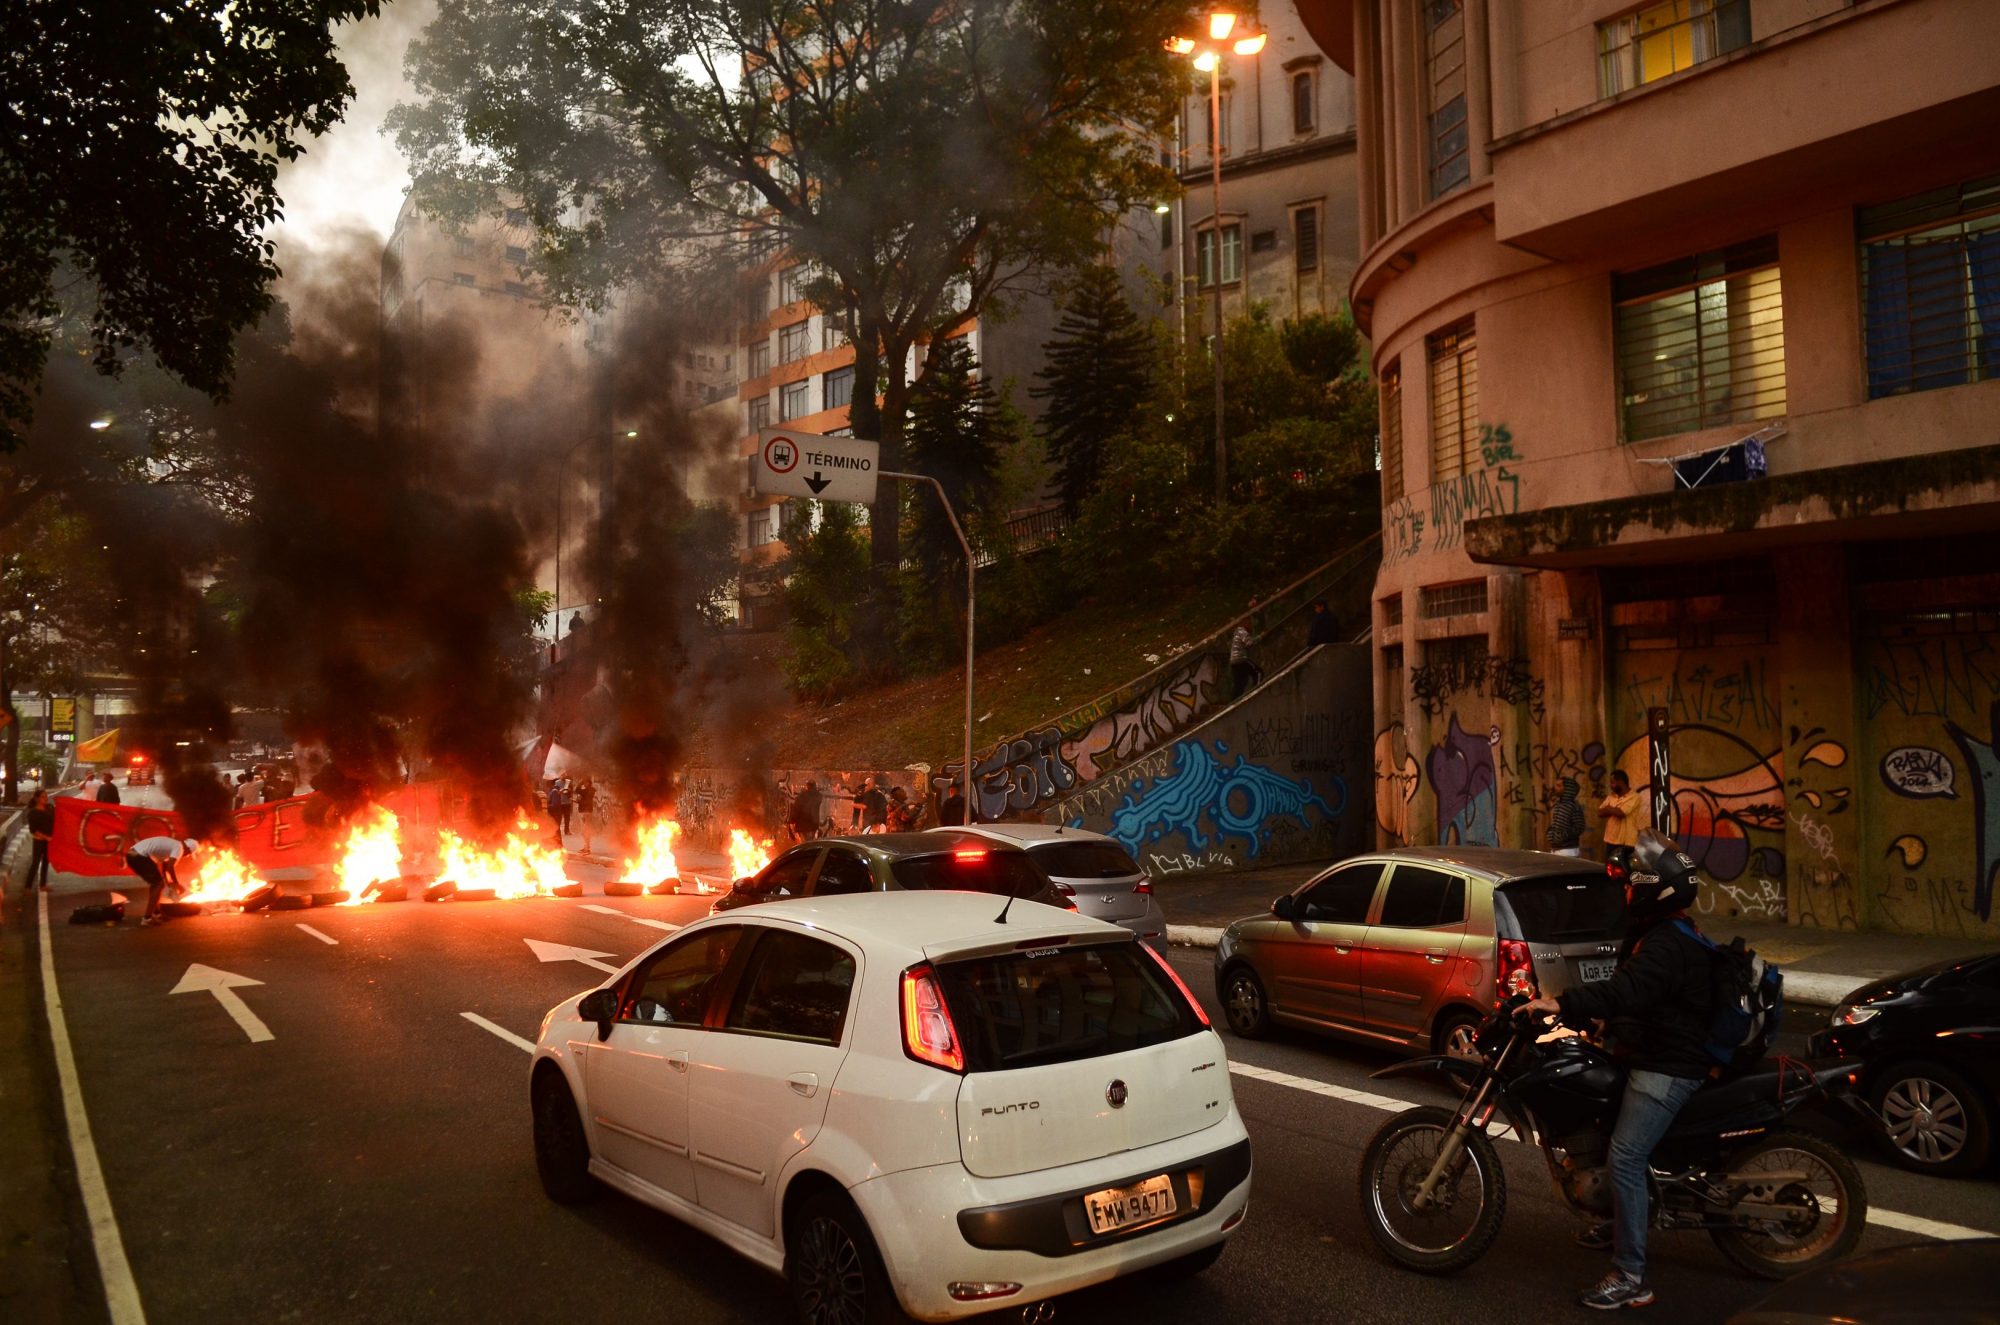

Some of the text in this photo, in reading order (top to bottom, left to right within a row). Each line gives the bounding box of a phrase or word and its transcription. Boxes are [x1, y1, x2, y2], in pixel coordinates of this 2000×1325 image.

[806, 450, 871, 471] TÉRMINO
[79, 801, 307, 857] GOPE
[982, 1101, 1040, 1116] PUNTO
[1092, 1201, 1126, 1229] FMW
[1129, 1189, 1168, 1217] 9477
